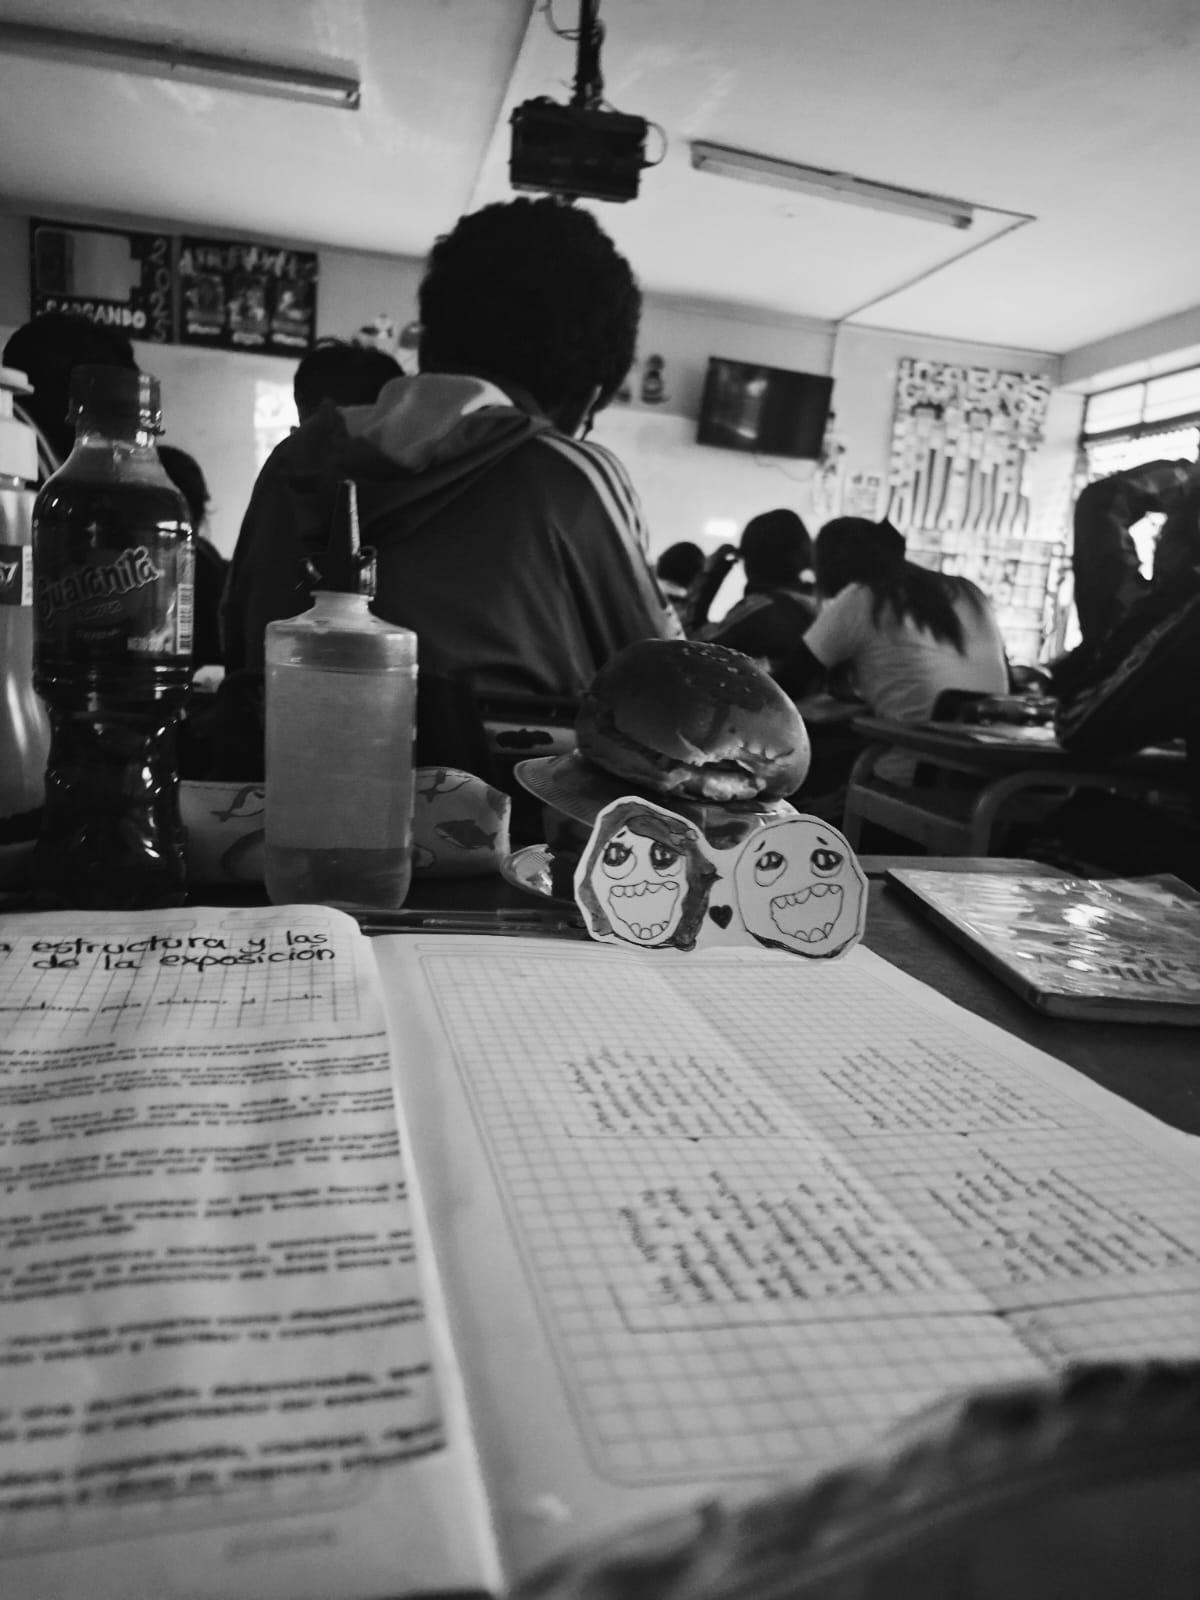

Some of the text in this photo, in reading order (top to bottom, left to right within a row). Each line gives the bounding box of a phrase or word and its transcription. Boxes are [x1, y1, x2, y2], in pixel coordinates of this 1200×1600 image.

[31, 935, 227, 955] estructura
[240, 938, 266, 954] y
[286, 930, 328, 946] las
[32, 955, 80, 970] de
[104, 954, 142, 971] la
